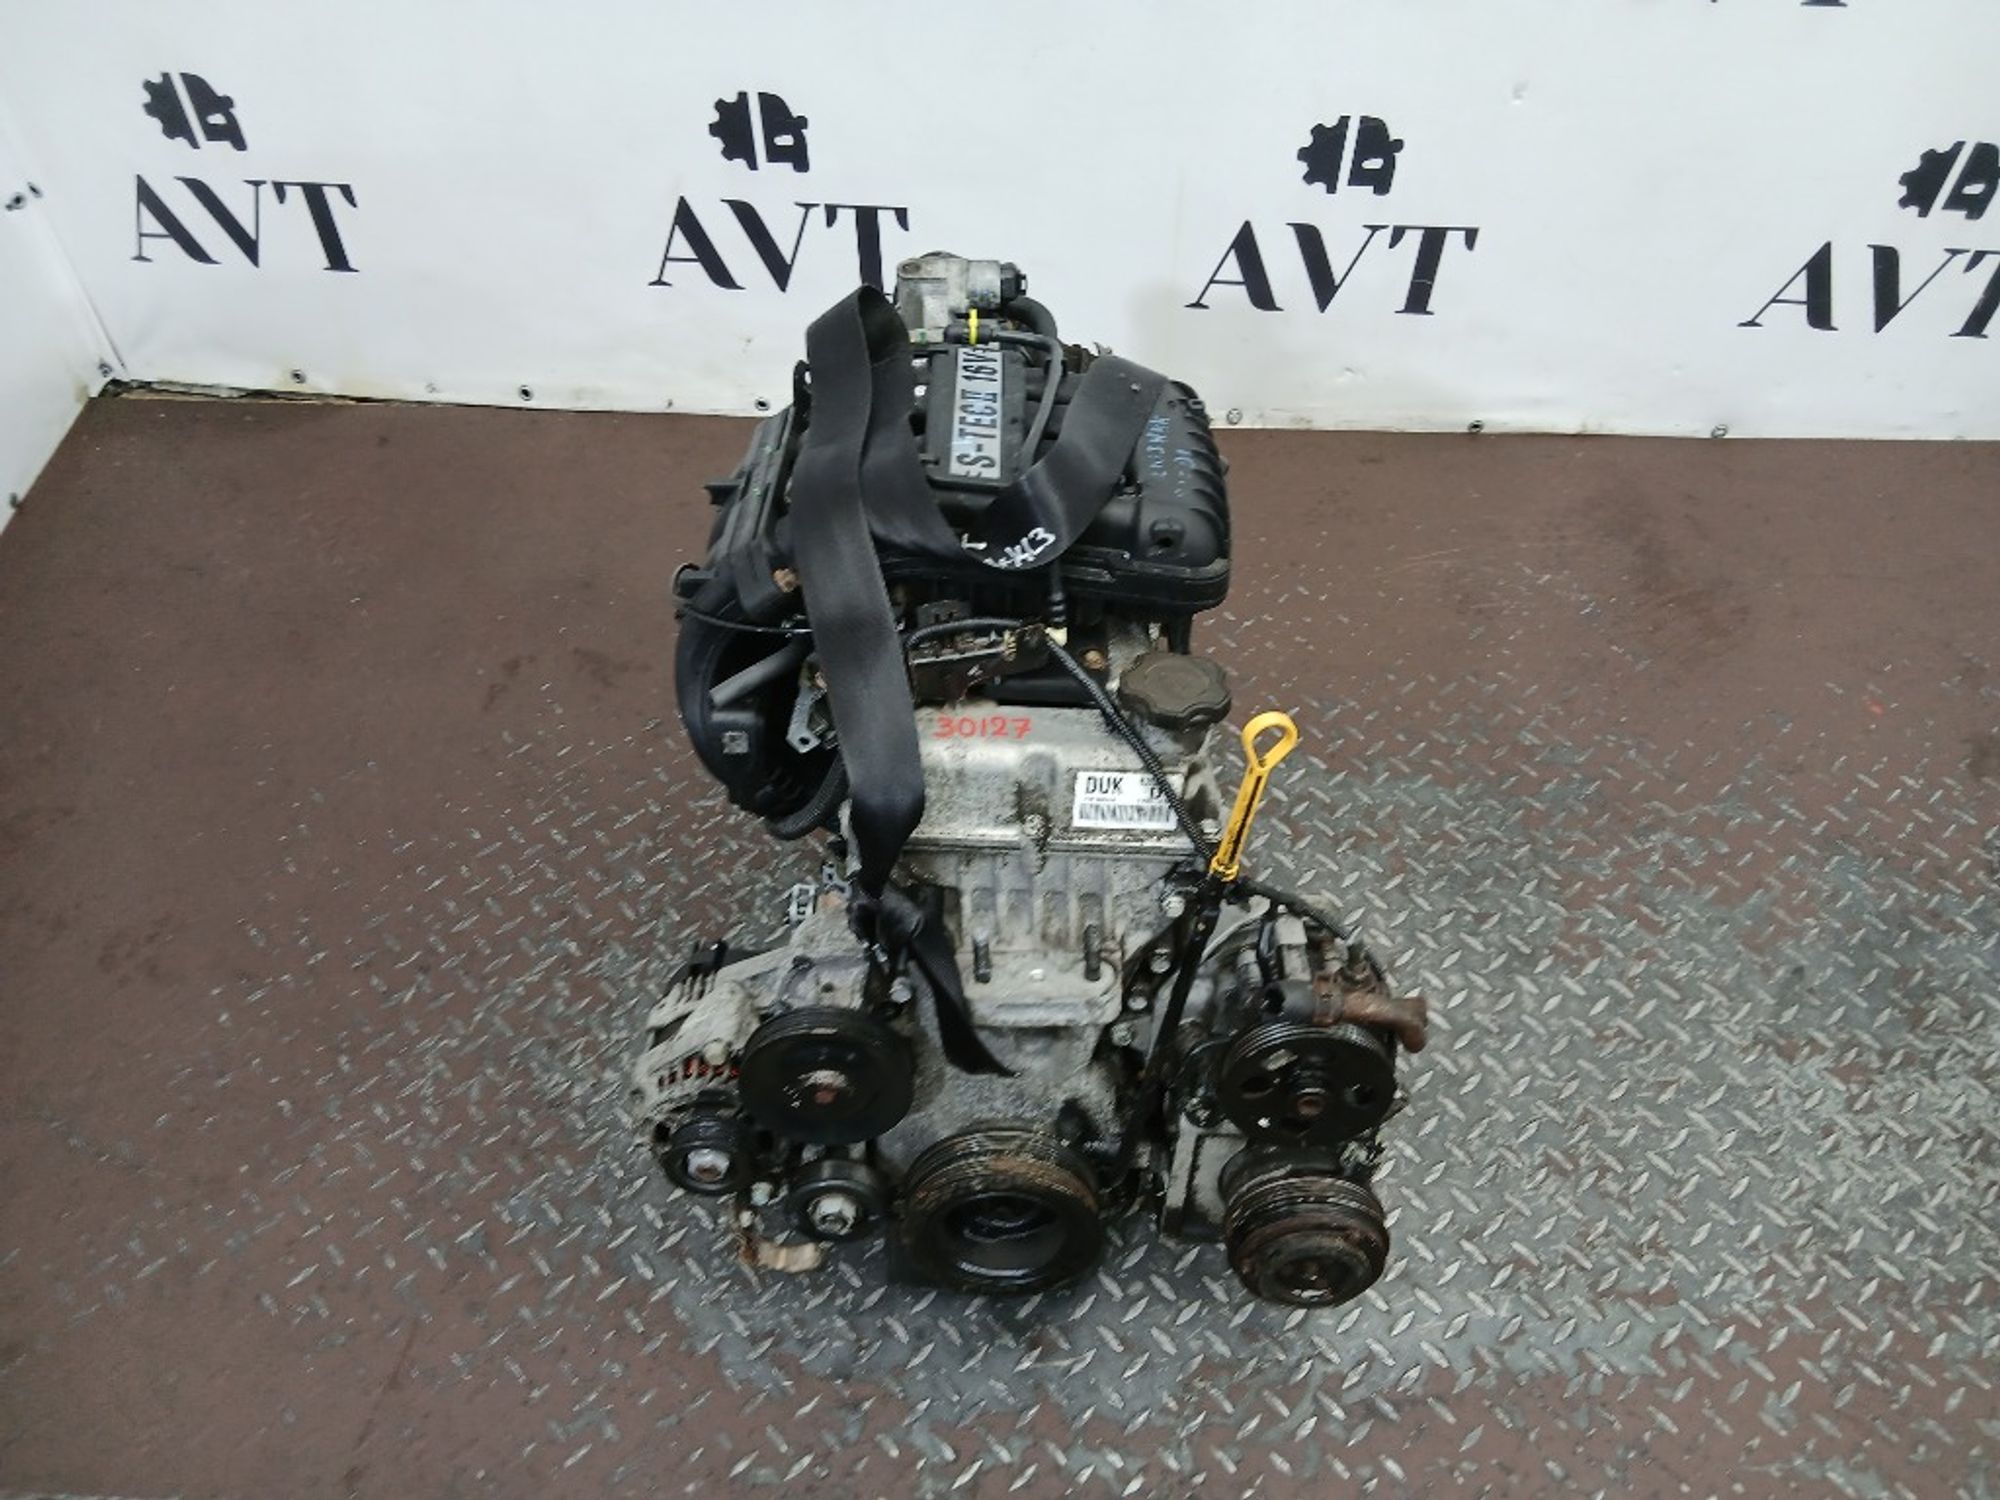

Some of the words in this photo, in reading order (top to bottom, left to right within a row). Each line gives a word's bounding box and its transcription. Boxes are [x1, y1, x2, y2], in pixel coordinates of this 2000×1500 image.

[131, 174, 359, 273] AVT
[648, 195, 909, 297] AVT
[1185, 220, 1479, 316] AVT
[1737, 241, 2000, 339] AVT
[933, 714, 1031, 739] 30127
[1086, 776, 1122, 795] DUK
